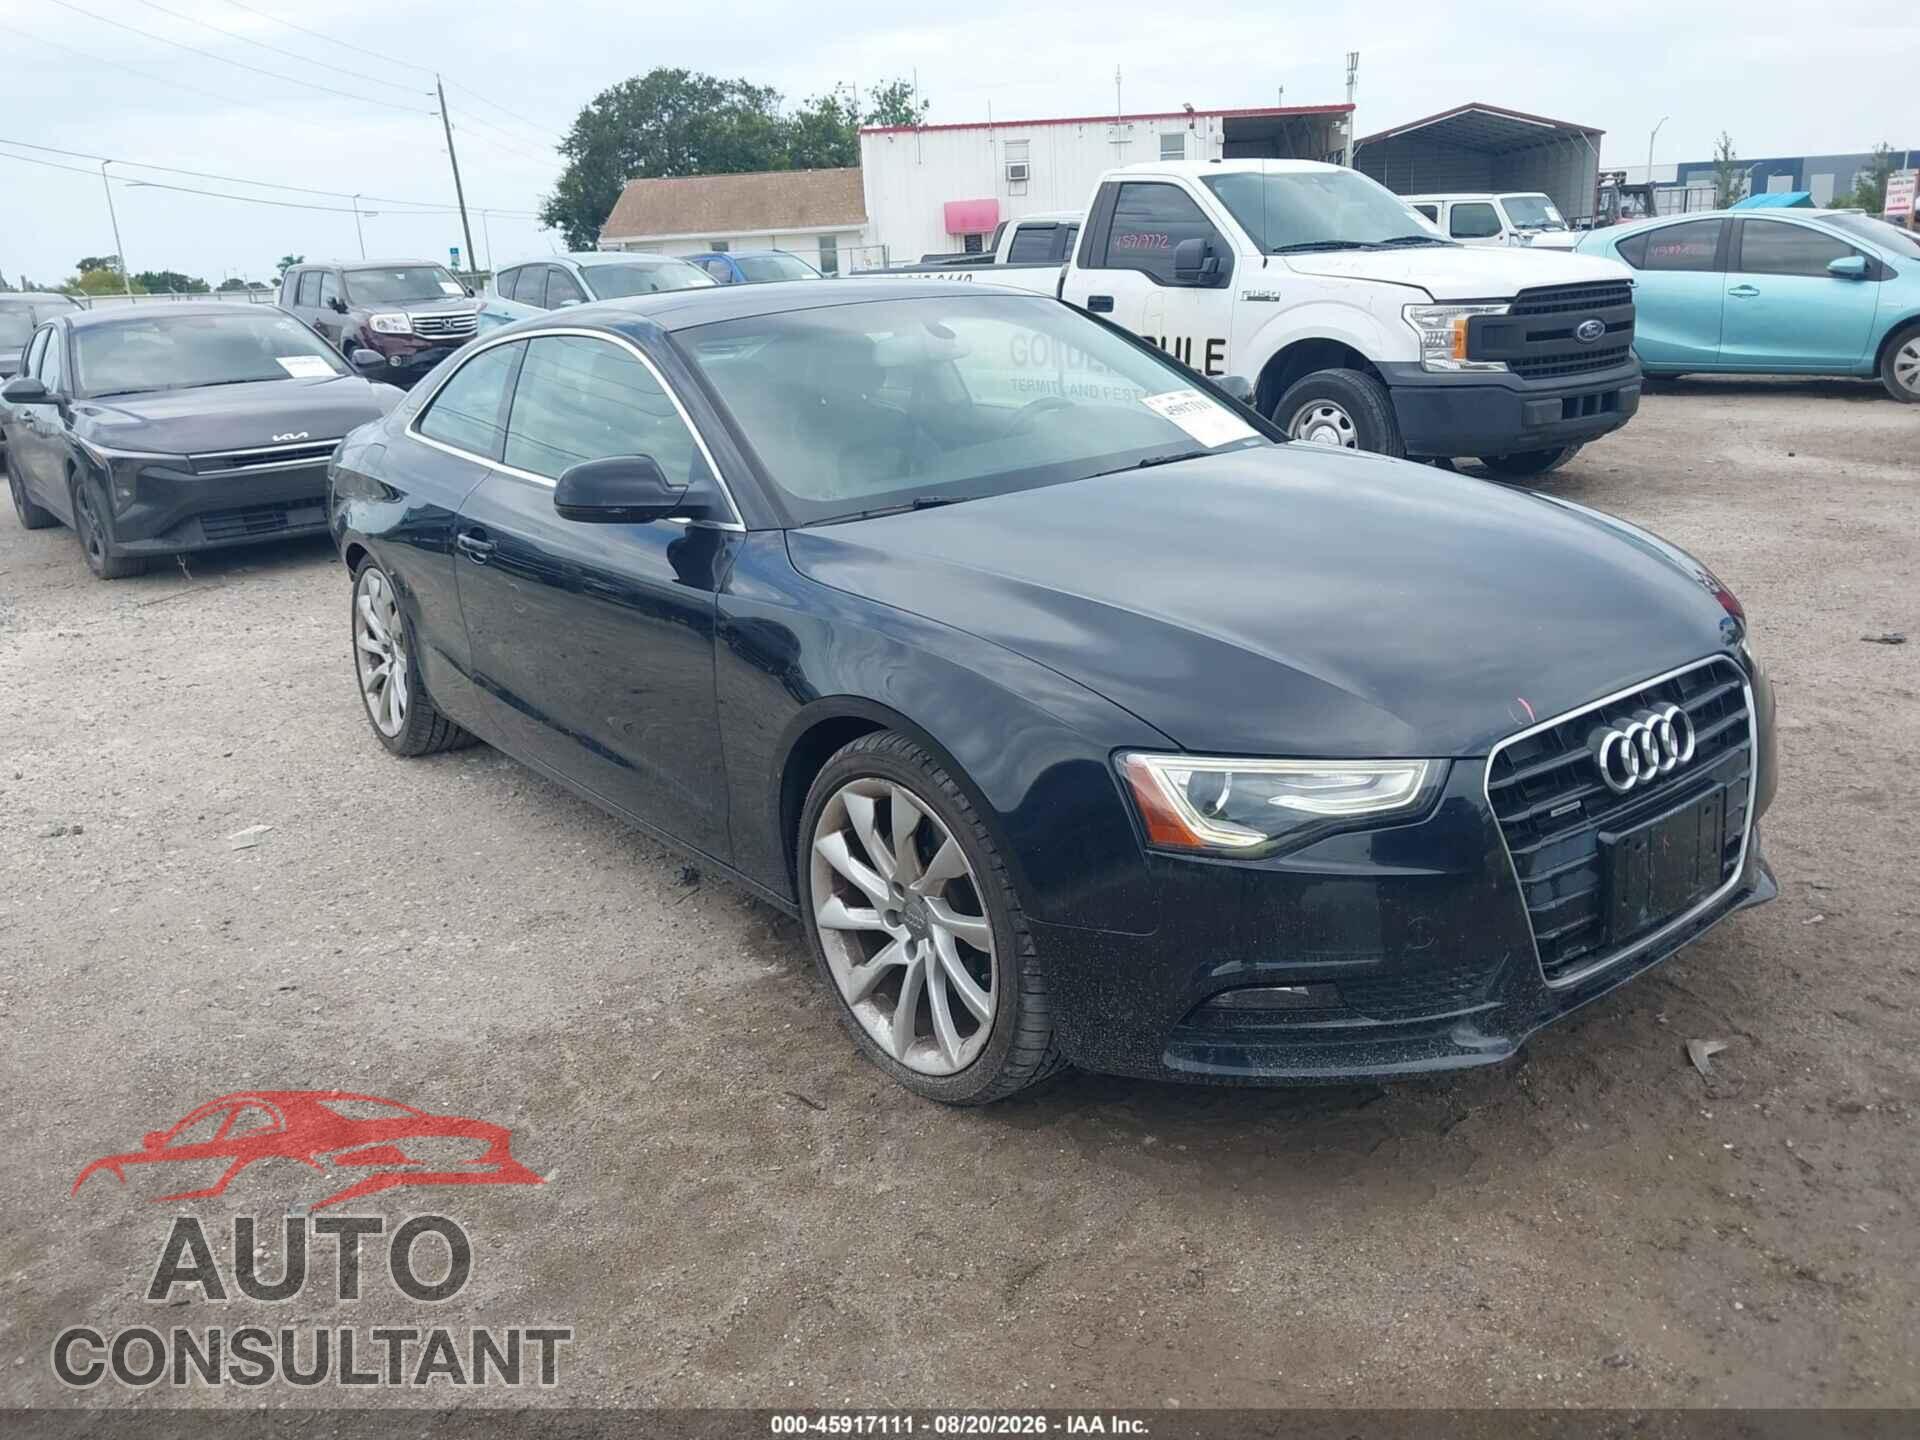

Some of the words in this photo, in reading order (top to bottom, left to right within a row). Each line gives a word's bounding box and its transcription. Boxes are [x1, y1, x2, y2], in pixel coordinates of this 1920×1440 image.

[1010, 334, 1118, 374] GOLDE
[1141, 336, 1226, 376] ULE
[1010, 378, 1067, 396] TERMIT
[1070, 384, 1099, 399] AND
